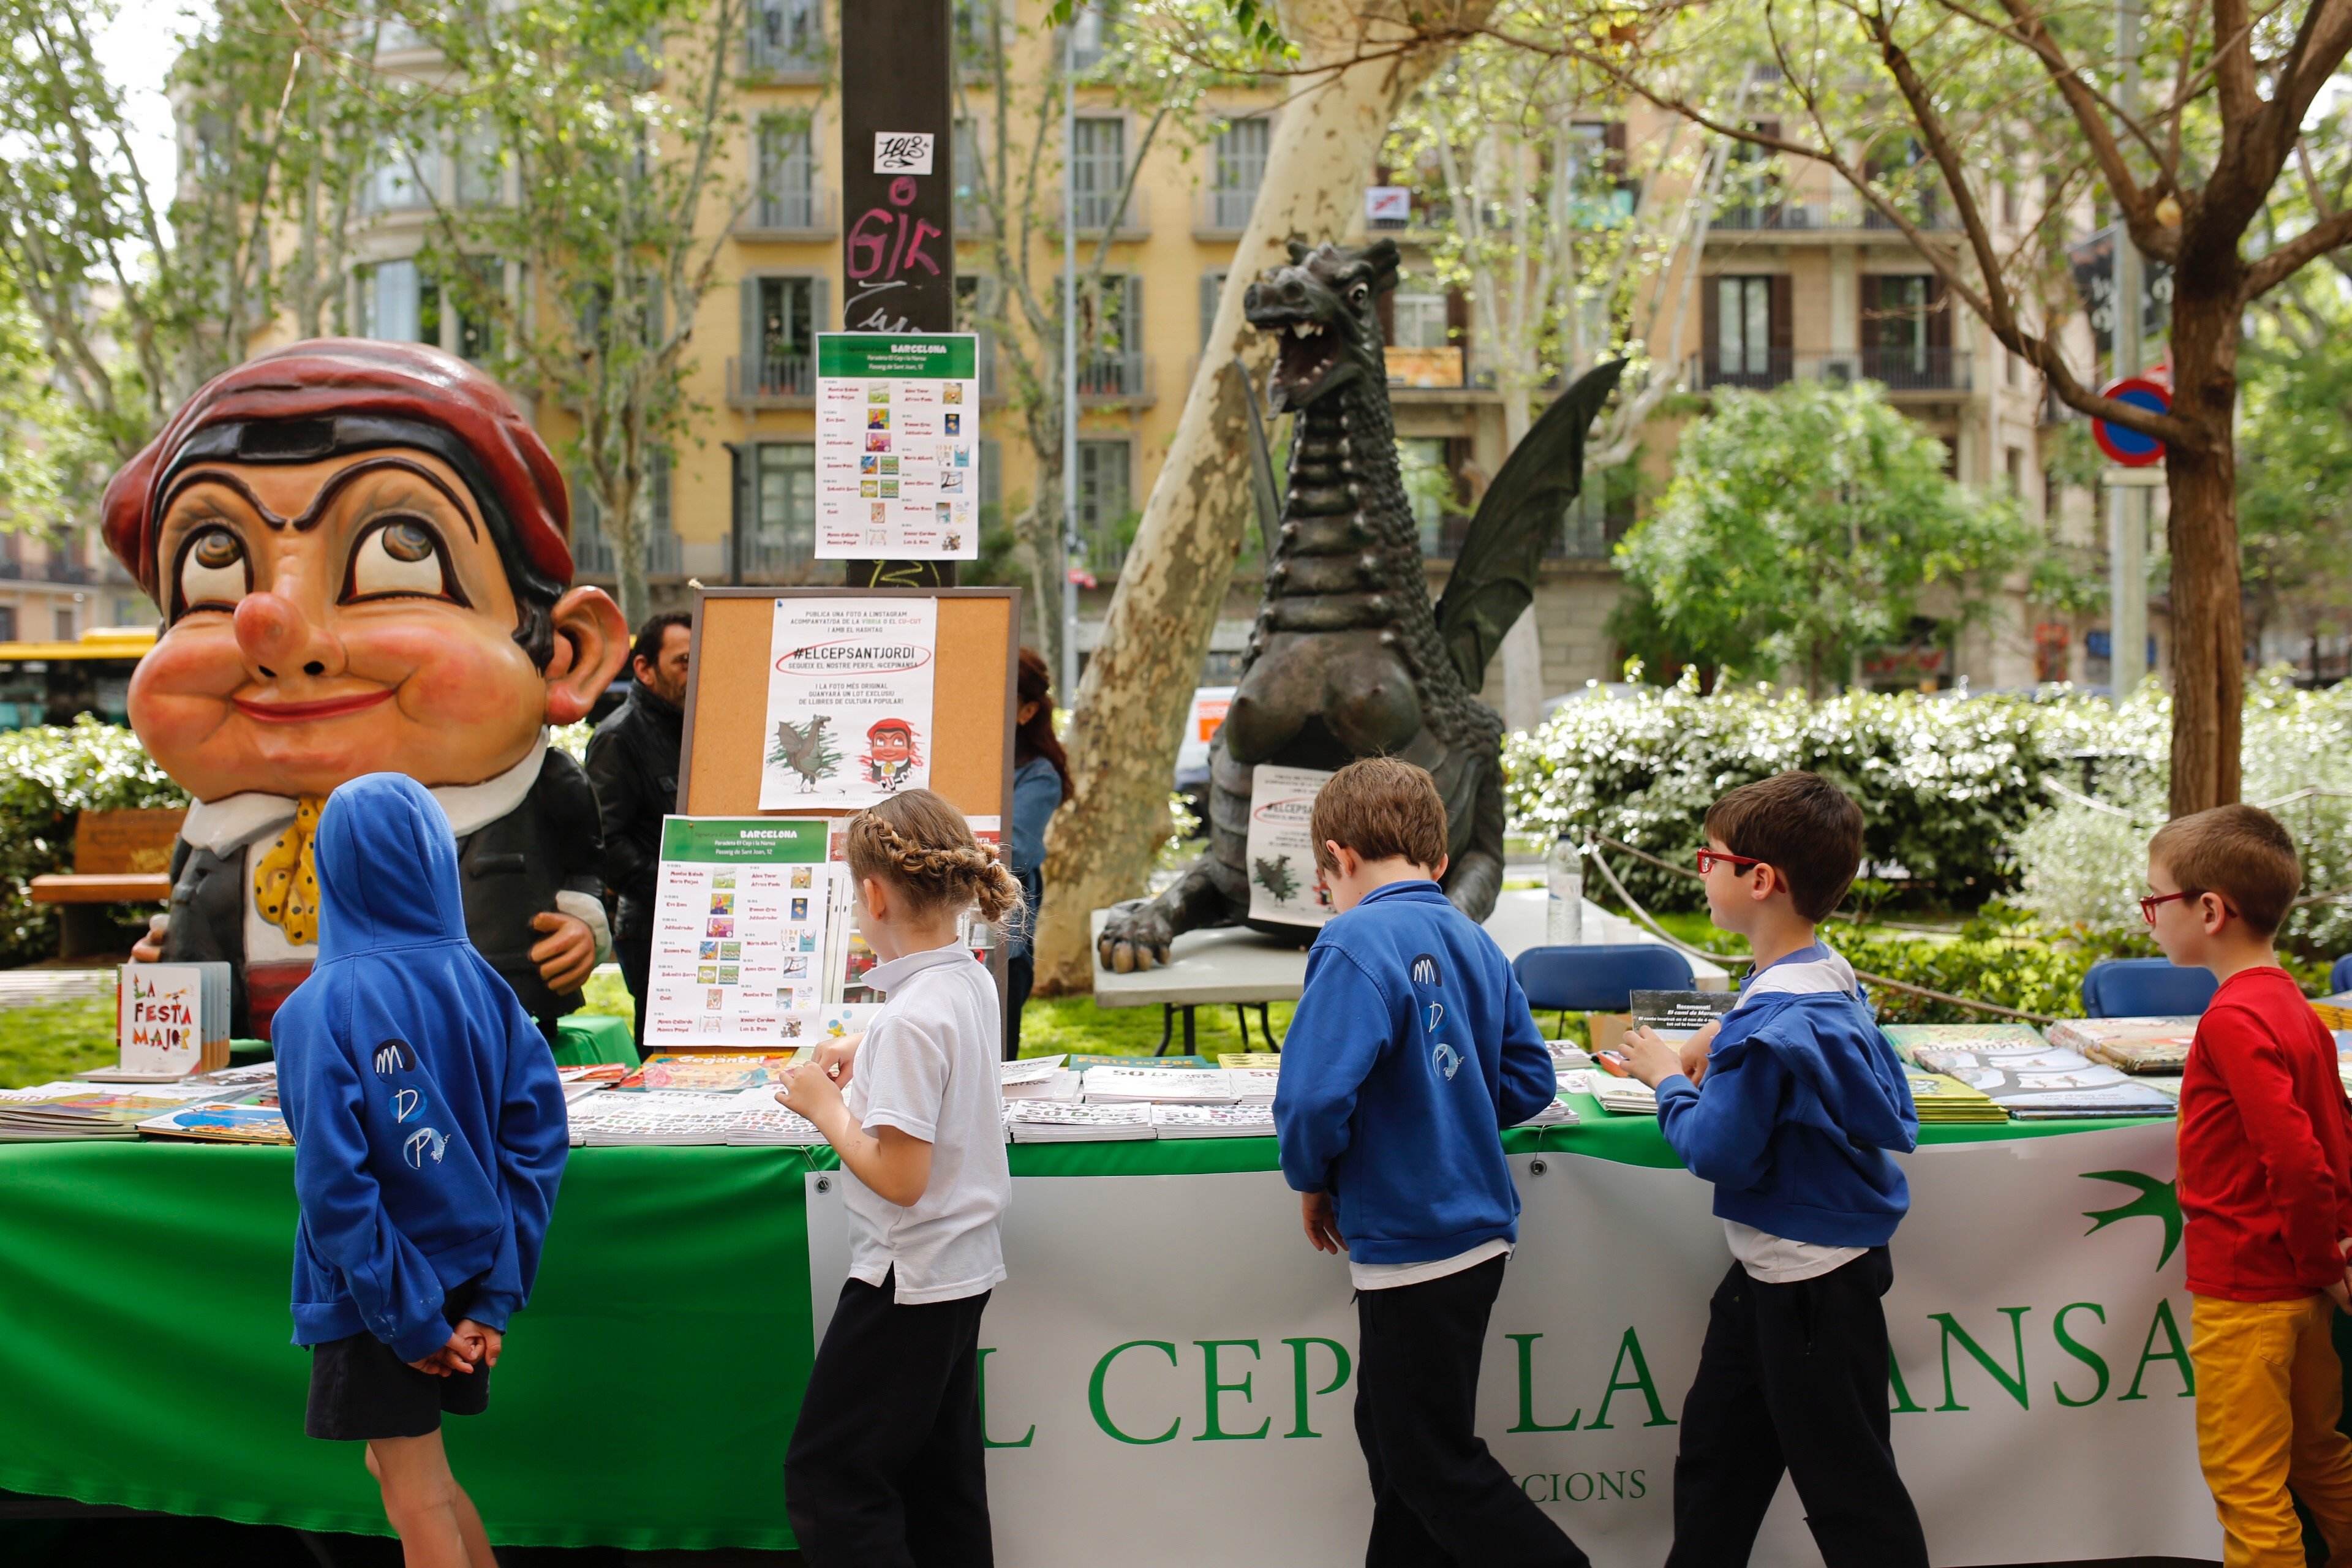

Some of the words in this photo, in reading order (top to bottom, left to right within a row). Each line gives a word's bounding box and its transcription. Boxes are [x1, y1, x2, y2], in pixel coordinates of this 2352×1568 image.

[891, 344, 947, 353] BARCELONA
[794, 647, 914, 660] #ELCEPSANTJORDI
[740, 830, 798, 839] BARCELONA
[134, 973, 156, 1000] LA
[135, 1002, 192, 1025] FESTA
[133, 1027, 190, 1052] MAJOR
[977, 1348, 1035, 1448] L
[1088, 1337, 1352, 1445] CEP
[1505, 1326, 1678, 1433] LA
[1889, 1298, 2195, 1413] NSA
[1521, 1470, 1646, 1502] CIONS
